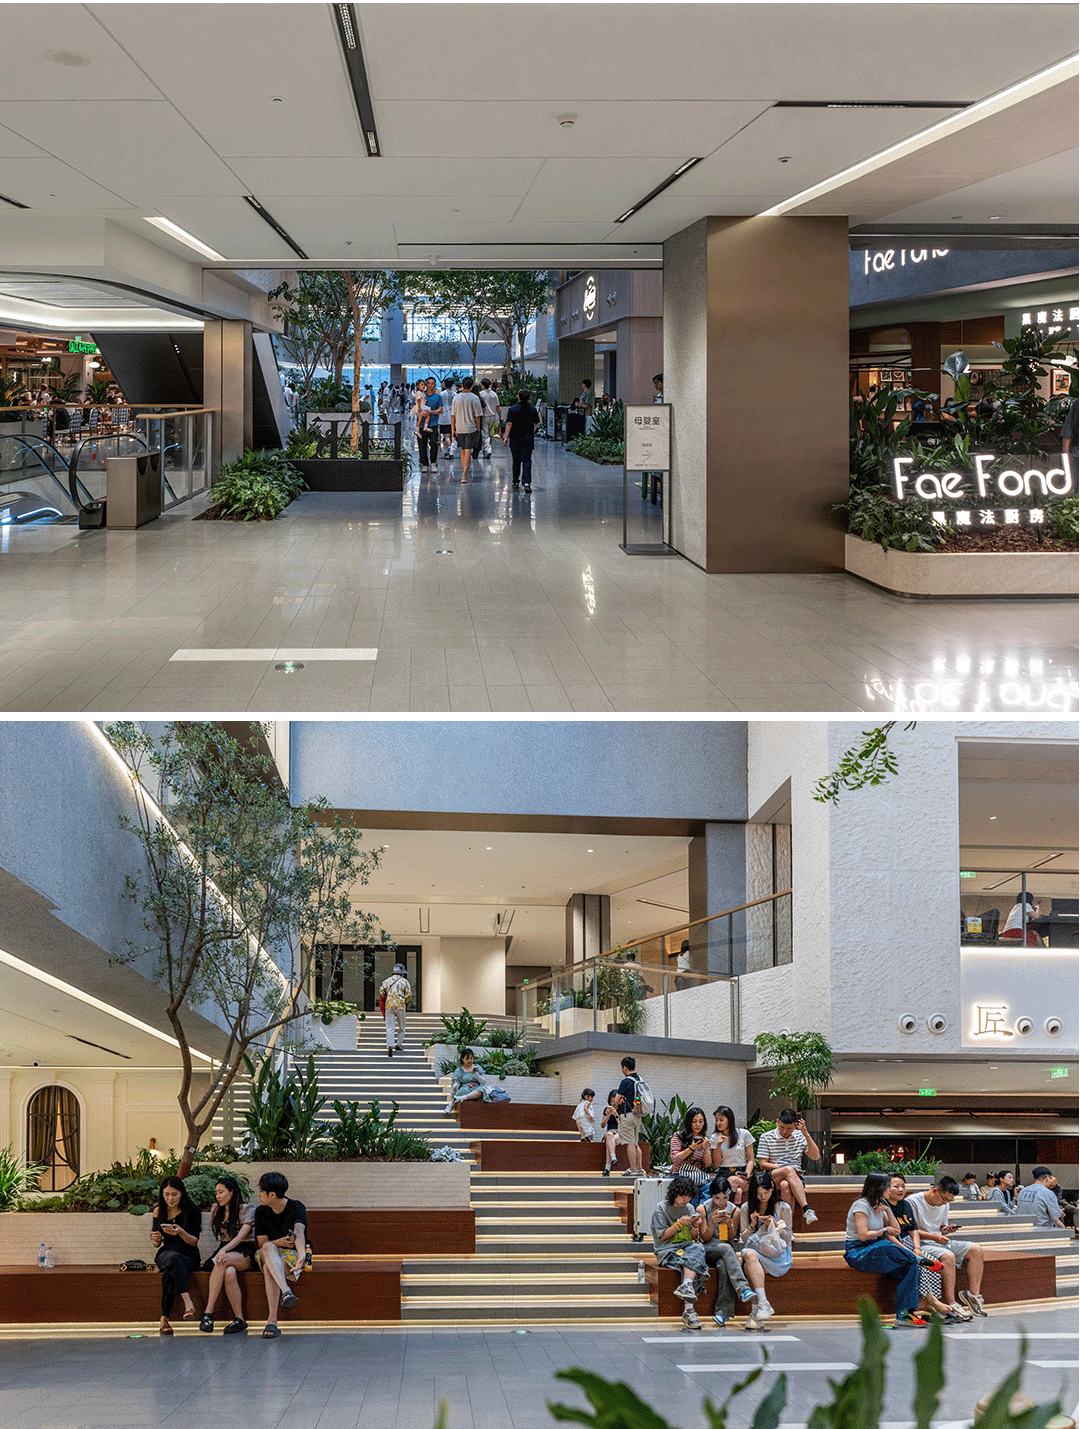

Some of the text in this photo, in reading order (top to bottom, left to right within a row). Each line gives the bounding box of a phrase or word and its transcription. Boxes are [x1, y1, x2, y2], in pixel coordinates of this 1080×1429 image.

[634, 416, 661, 426] 母婴室
[893, 453, 1072, 500] Fae Fond
[973, 1005, 1014, 1036] 匠
